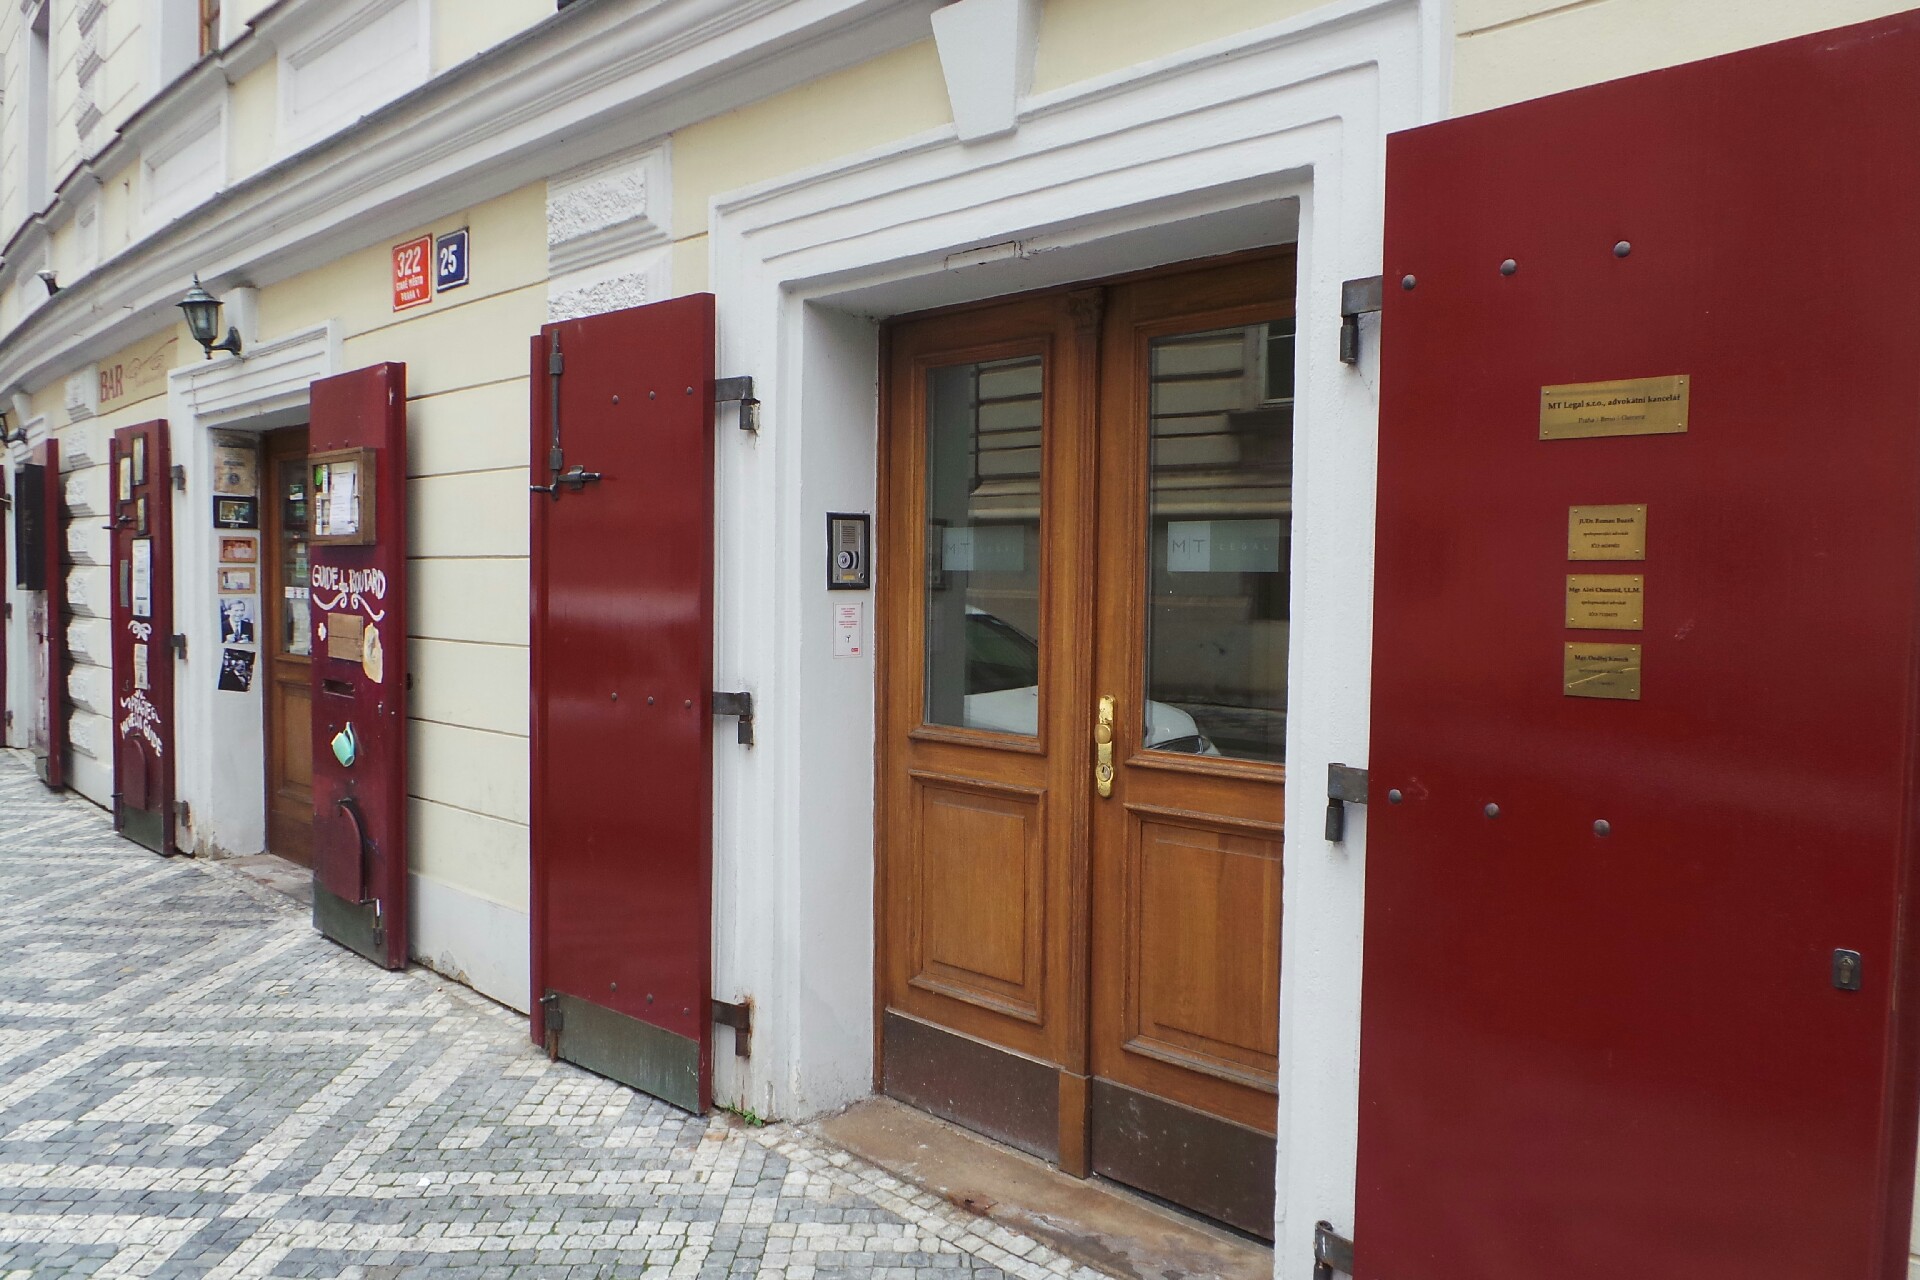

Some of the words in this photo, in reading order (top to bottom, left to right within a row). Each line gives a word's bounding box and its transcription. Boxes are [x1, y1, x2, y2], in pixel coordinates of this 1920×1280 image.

[397, 246, 421, 278] 322
[440, 244, 458, 276] 25
[400, 289, 416, 302] PRAHA
[100, 364, 124, 404] BAR
[1547, 402, 1562, 410] MT
[1563, 400, 1585, 410] Legal
[1647, 393, 1681, 403] kancelář
[312, 564, 339, 591] GUIDE
[348, 567, 386, 600] ROUTARD
